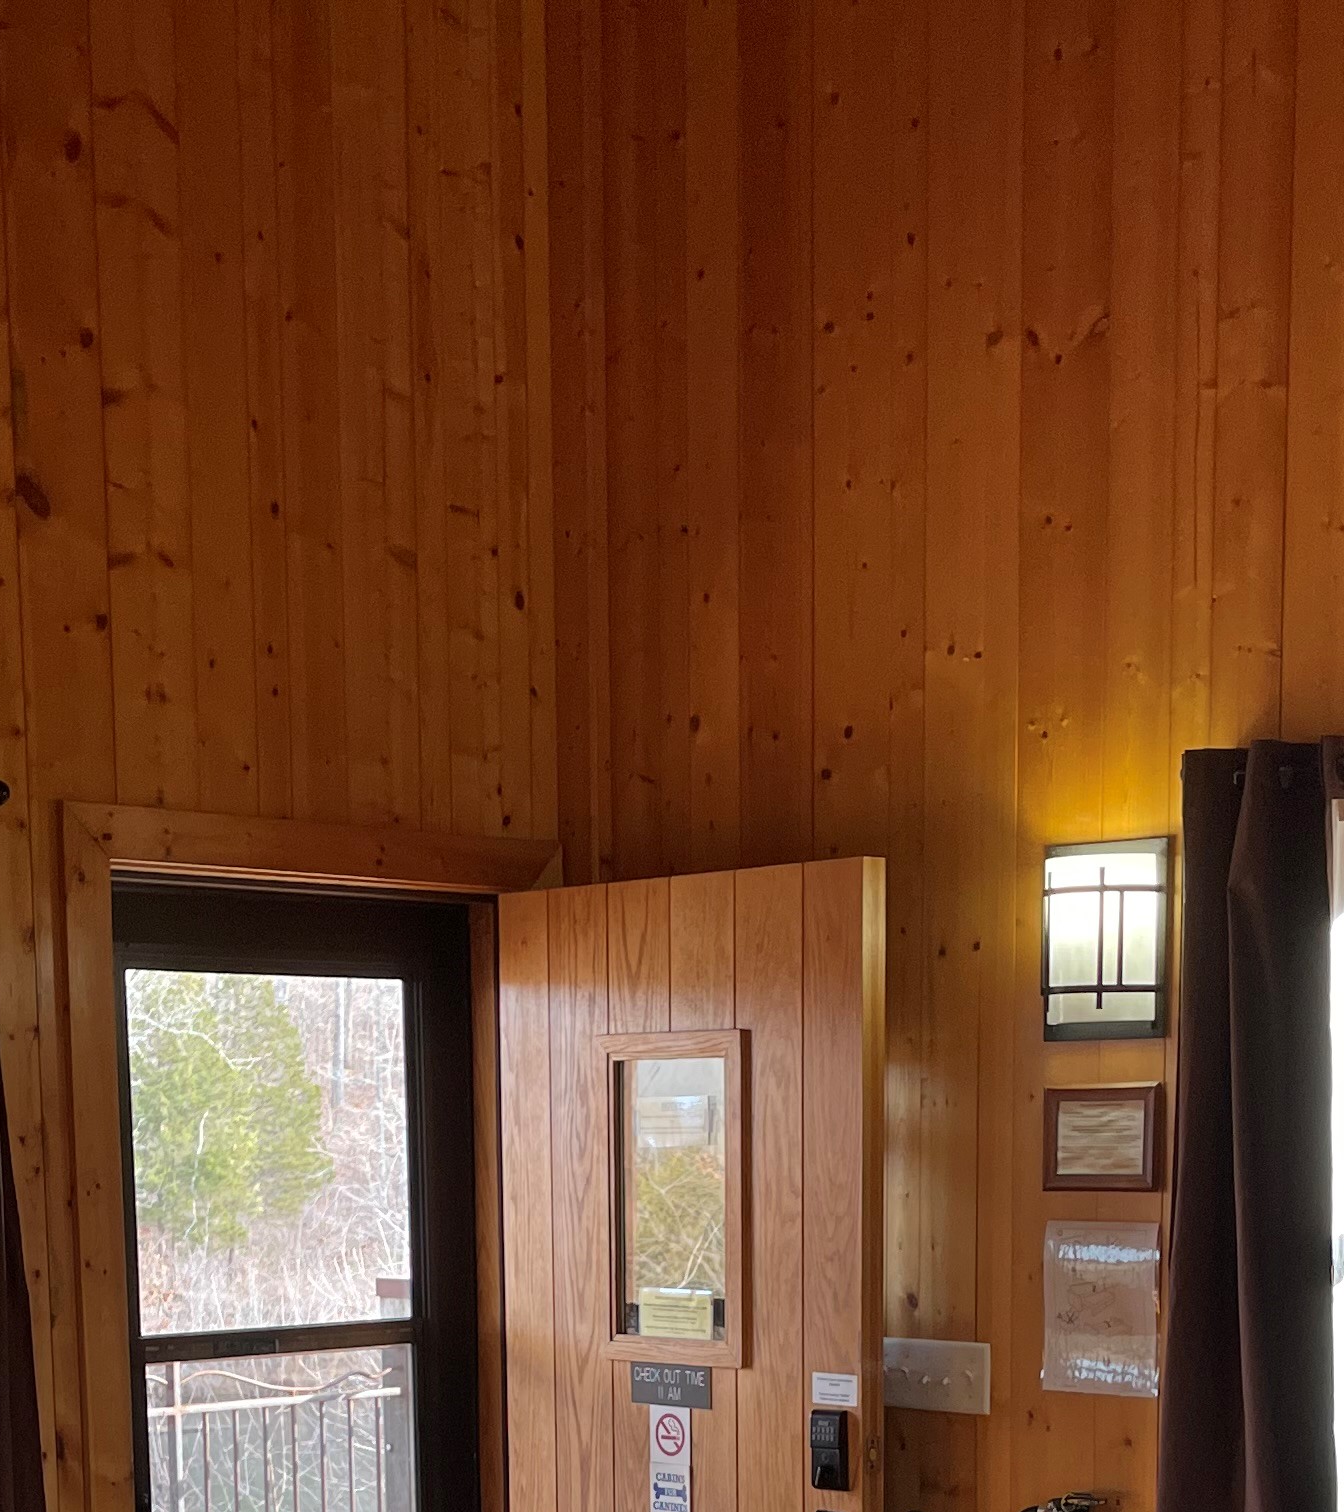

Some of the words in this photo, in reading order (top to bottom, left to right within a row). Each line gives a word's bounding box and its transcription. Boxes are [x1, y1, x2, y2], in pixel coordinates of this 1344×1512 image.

[633, 1366, 661, 1383] CHECK
[663, 1368, 681, 1385] OUT
[684, 1370, 705, 1387] TIME
[667, 1386, 681, 1401] AM
[655, 1472, 685, 1484] CABINS
[652, 1500, 688, 1512] CANINES
